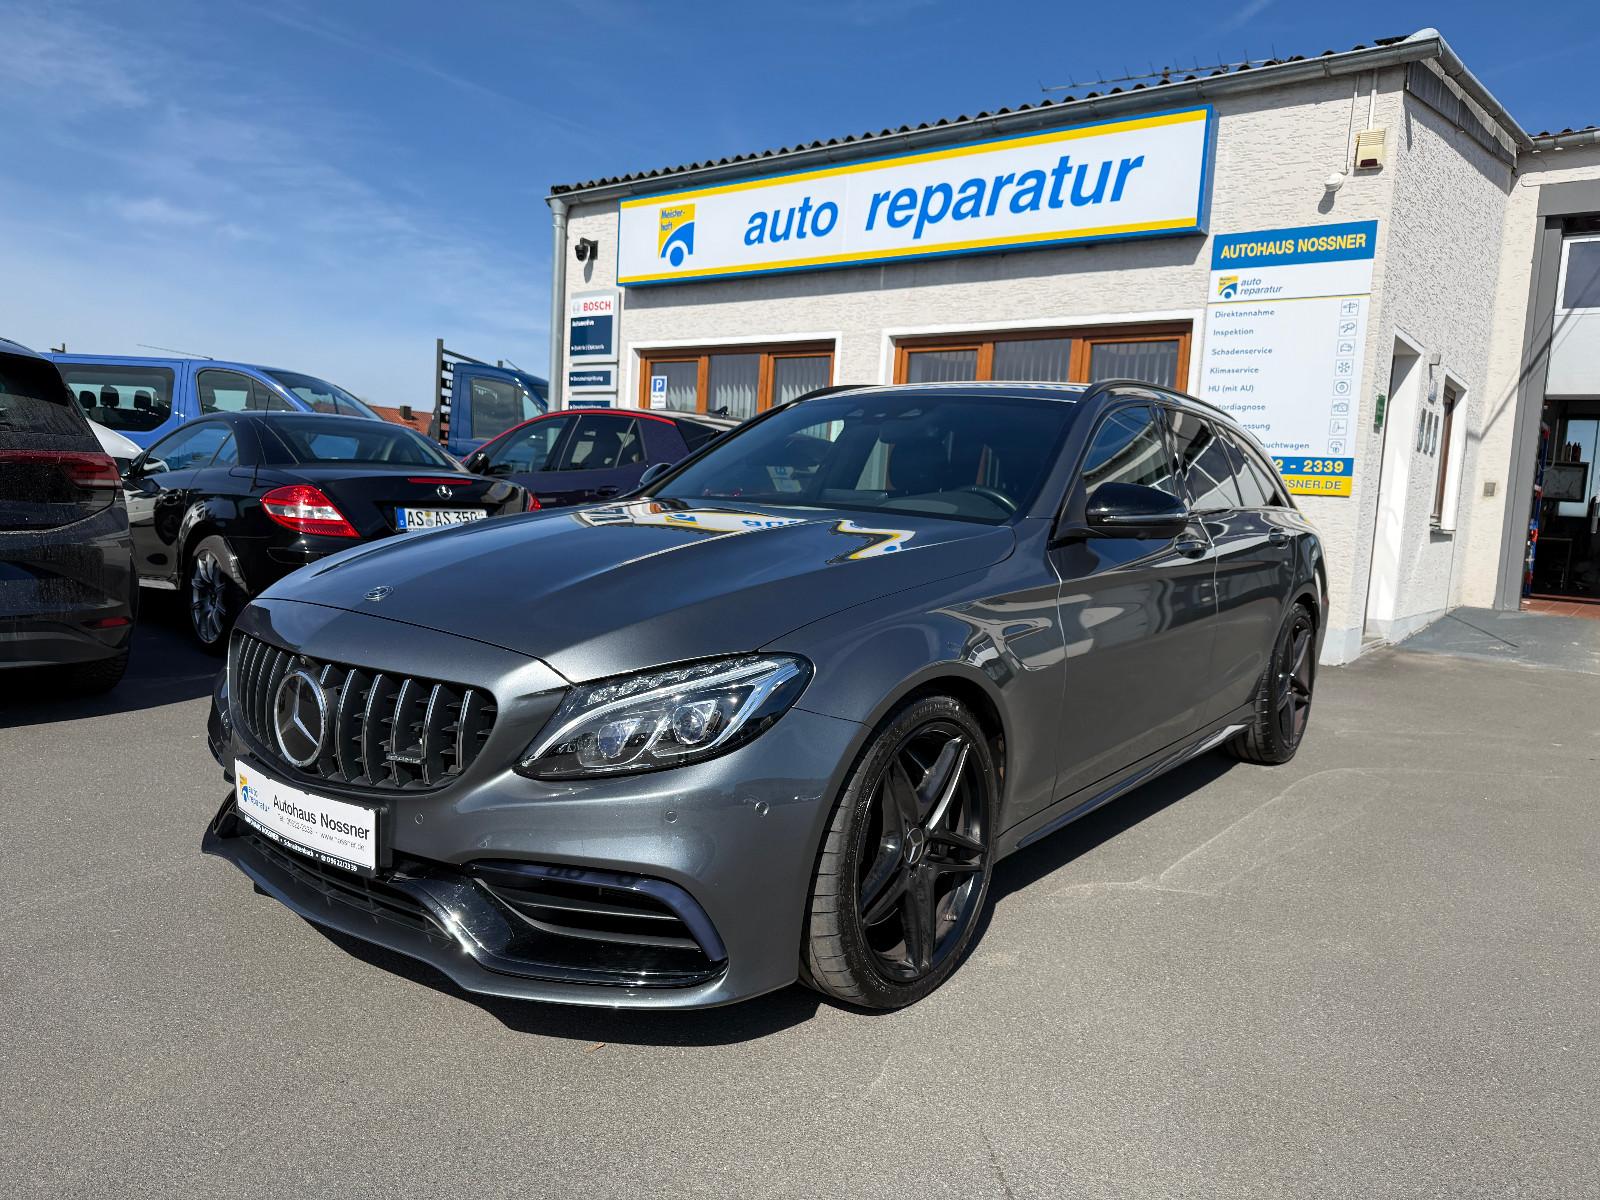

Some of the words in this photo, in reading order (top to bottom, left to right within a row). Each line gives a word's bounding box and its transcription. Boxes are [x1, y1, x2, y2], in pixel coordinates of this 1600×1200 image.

[744, 197, 838, 246] auto
[865, 155, 1144, 239] reparatur
[1221, 240, 1294, 259] AUTOHAUS
[1298, 233, 1366, 253] NOSSNER
[1241, 278, 1262, 286] auto
[1240, 286, 1283, 296] reparatur
[583, 301, 611, 311] BOSCH
[1215, 309, 1275, 318] Direktannahme
[1213, 328, 1254, 337] Inspektion
[1211, 347, 1272, 356] Schadenservice
[1222, 385, 1237, 393] (mit
[1303, 460, 1344, 473] 2339
[408, 511, 424, 526] AS
[436, 511, 451, 526] AS
[273, 794, 317, 825] Autohaus
[320, 812, 370, 840] Nossner
